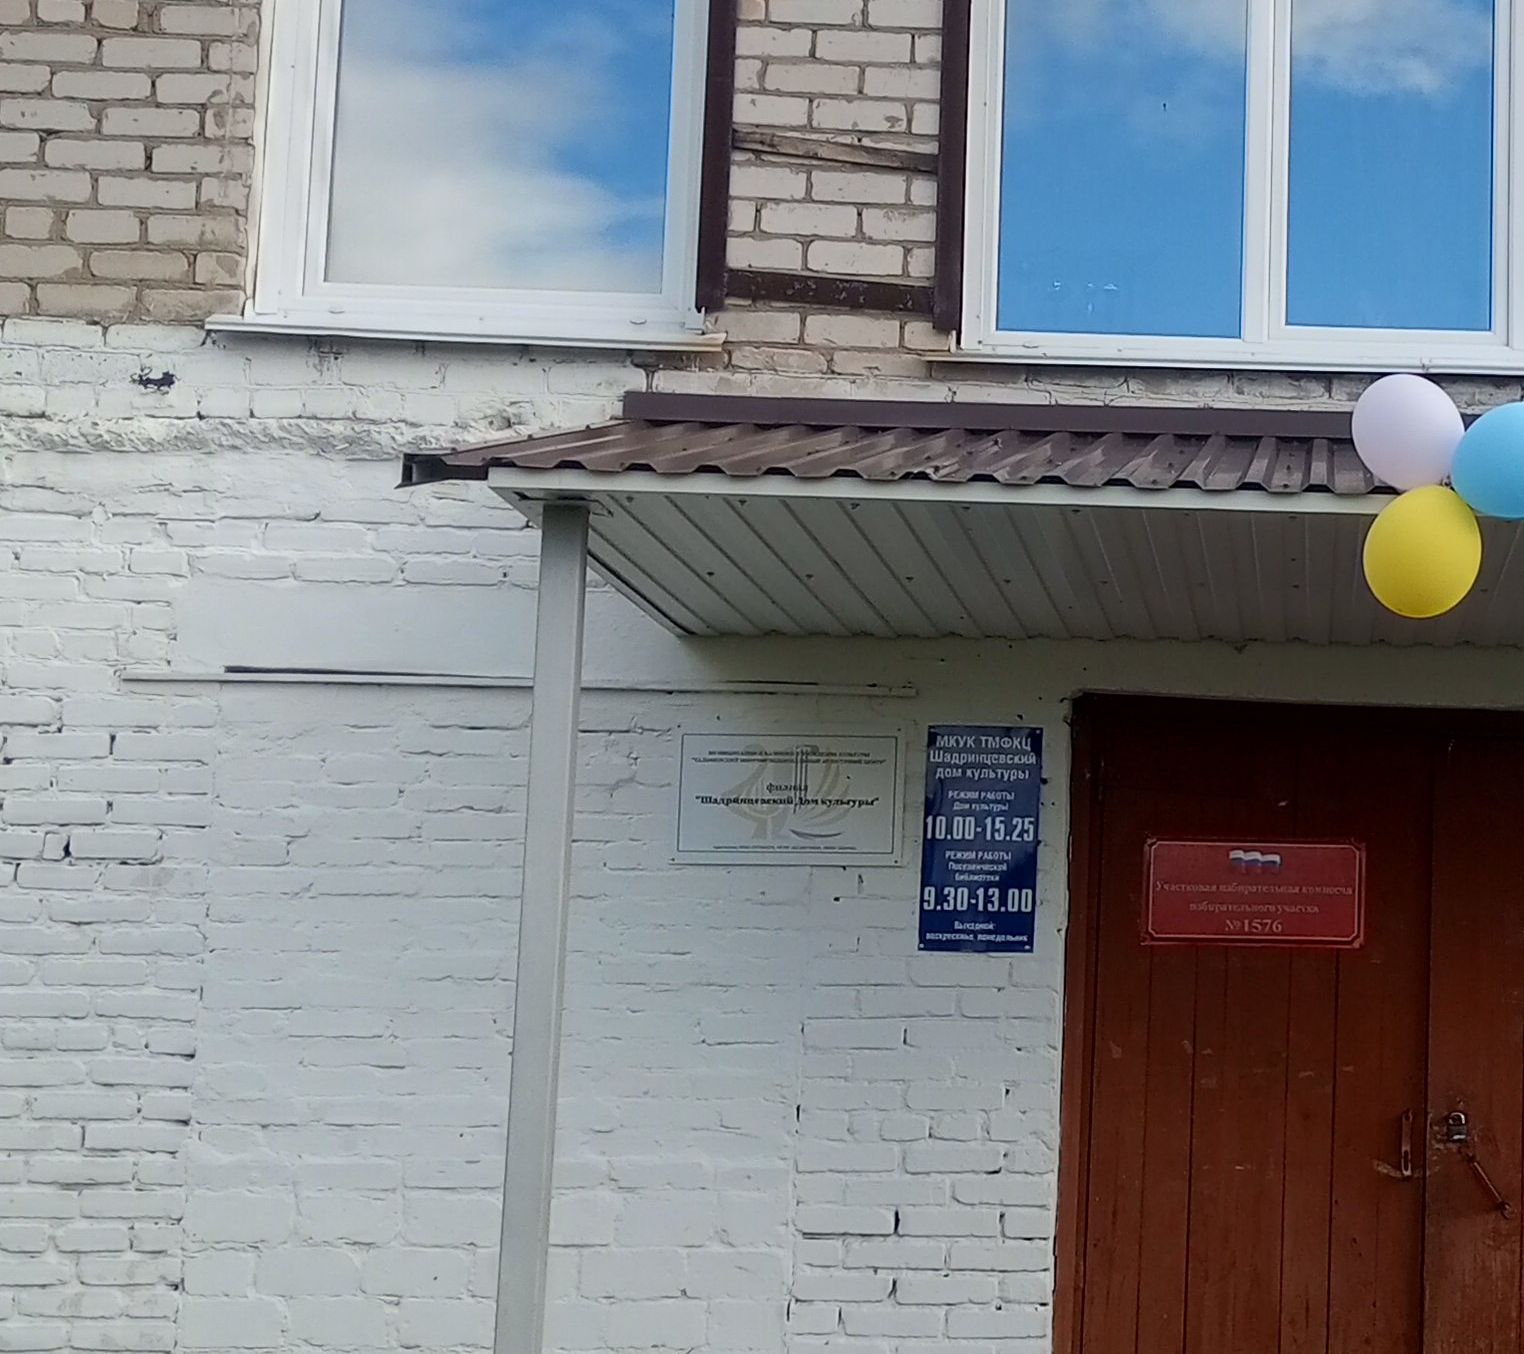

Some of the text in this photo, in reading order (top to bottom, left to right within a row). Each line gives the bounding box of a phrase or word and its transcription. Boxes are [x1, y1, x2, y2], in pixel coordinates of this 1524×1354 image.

[936, 735, 1031, 751] МКУК ТМФКЦ
[930, 750, 1037, 764] Шадринцевский
[966, 768, 1029, 781] культуры
[948, 790, 1015, 800] РЕЖИМ РАБОТЫ
[926, 815, 1035, 841] 10.00-15.25
[945, 850, 1012, 860] РЕЖИМ РАБОТЫ
[1156, 881, 1217, 891] Участковая
[923, 886, 1033, 912] 9.30-13.00
